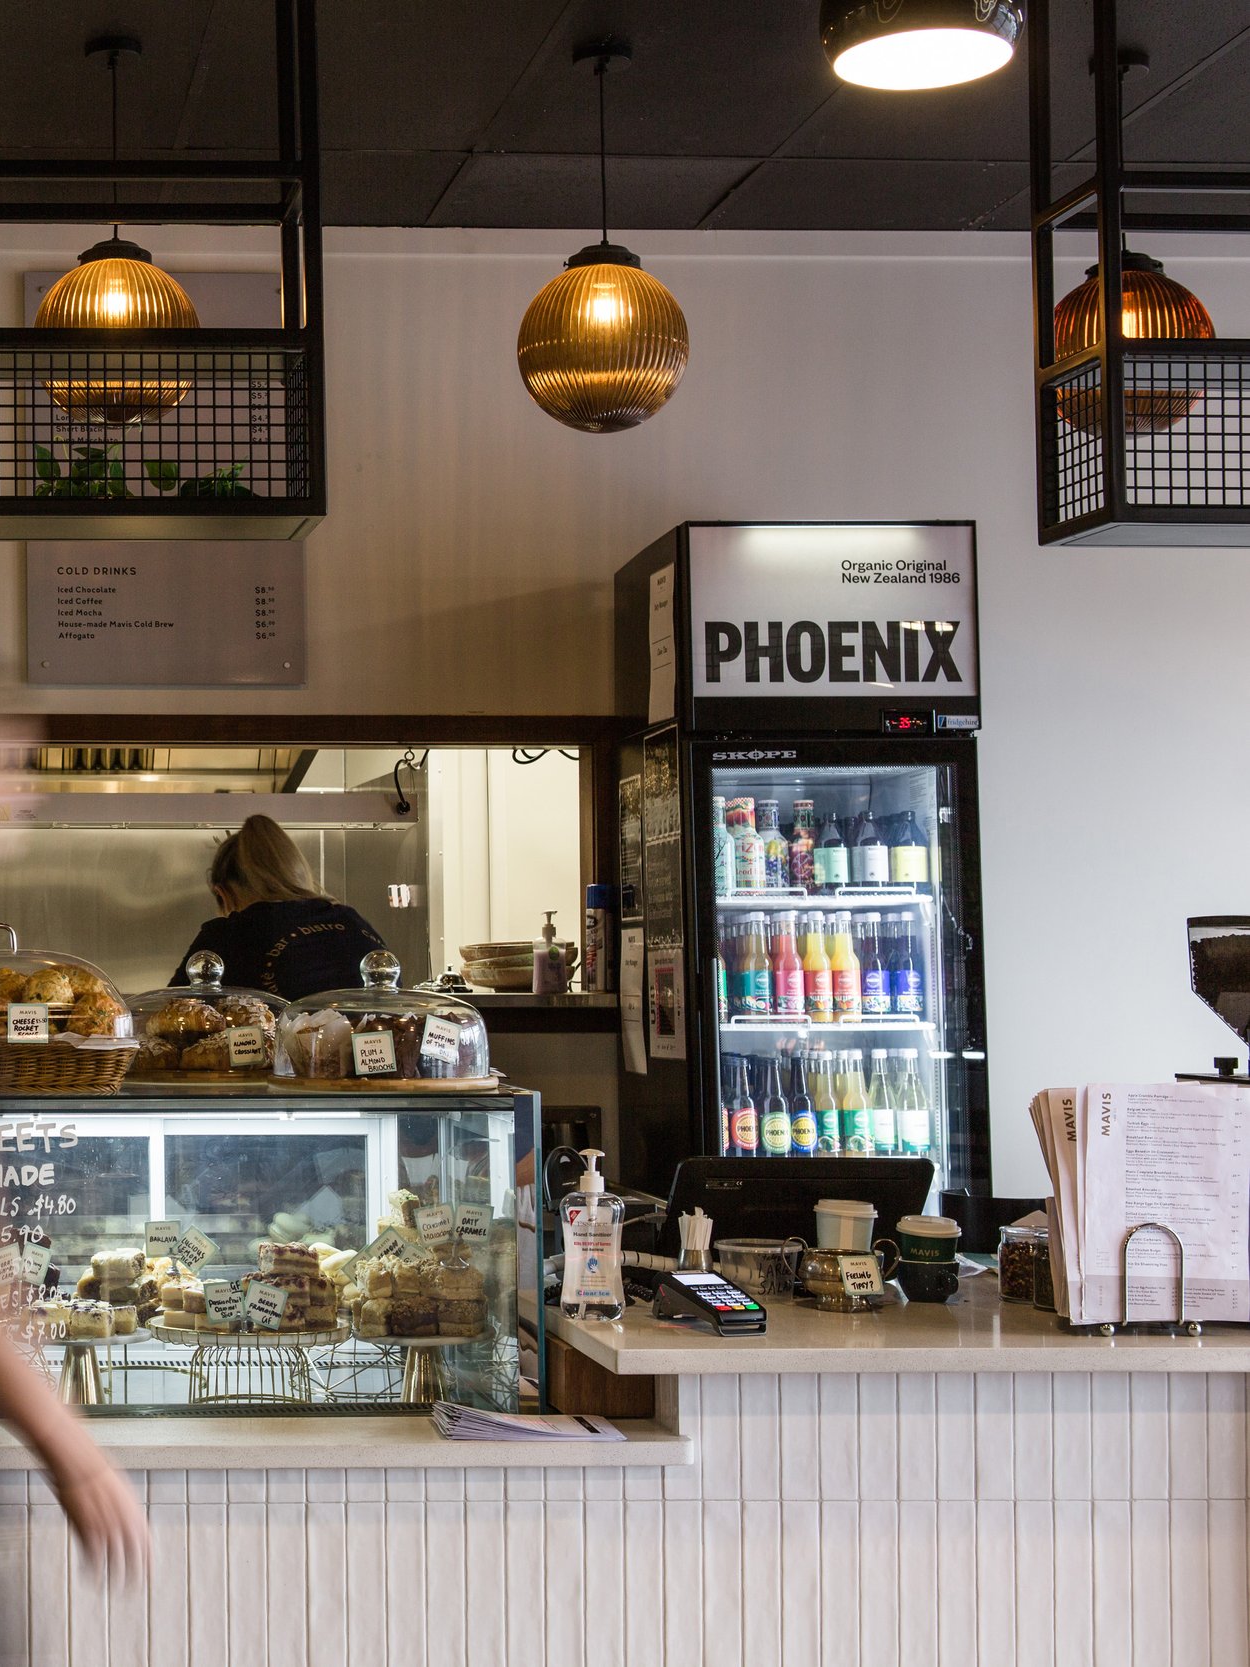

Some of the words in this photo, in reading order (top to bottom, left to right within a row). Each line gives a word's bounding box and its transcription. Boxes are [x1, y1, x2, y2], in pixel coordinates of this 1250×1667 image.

[56, 566, 89, 576] COLD
[93, 566, 137, 576] DRINKS
[841, 559, 893, 573] Organic
[896, 559, 948, 573] Original
[841, 573, 871, 584] New
[873, 573, 926, 584] Zealand
[929, 573, 961, 584] 1986
[57, 586, 73, 594] Iced
[75, 586, 117, 594] Chocolate
[57, 597, 73, 605] Iced
[75, 597, 103, 605] Coffee
[57, 609, 73, 617] Iced
[75, 609, 103, 617] Mocha
[58, 620, 108, 628] House-made
[109, 620, 133, 628] Mavis
[134, 620, 153, 628] Cold
[154, 620, 174, 628] Brew
[58, 632, 95, 640] Affogato
[704, 620, 963, 683] PHOENIX
[712, 749, 797, 762] SKOPE
[266, 937, 289, 957] bar
[298, 921, 346, 936] bistro
[360, 1049, 378, 1057] PLUM
[360, 1057, 386, 1066] ALMOND
[368, 1063, 395, 1073] BRIOCHE
[1101, 1092, 1112, 1137] MAVIS
[1061, 1098, 1077, 1142] MAVIS
[27, 1194, 77, 1220] $4.80
[456, 1226, 487, 1237] CARAMEL
[910, 1247, 940, 1258] MAVIS
[845, 1271, 871, 1281] FEELING
